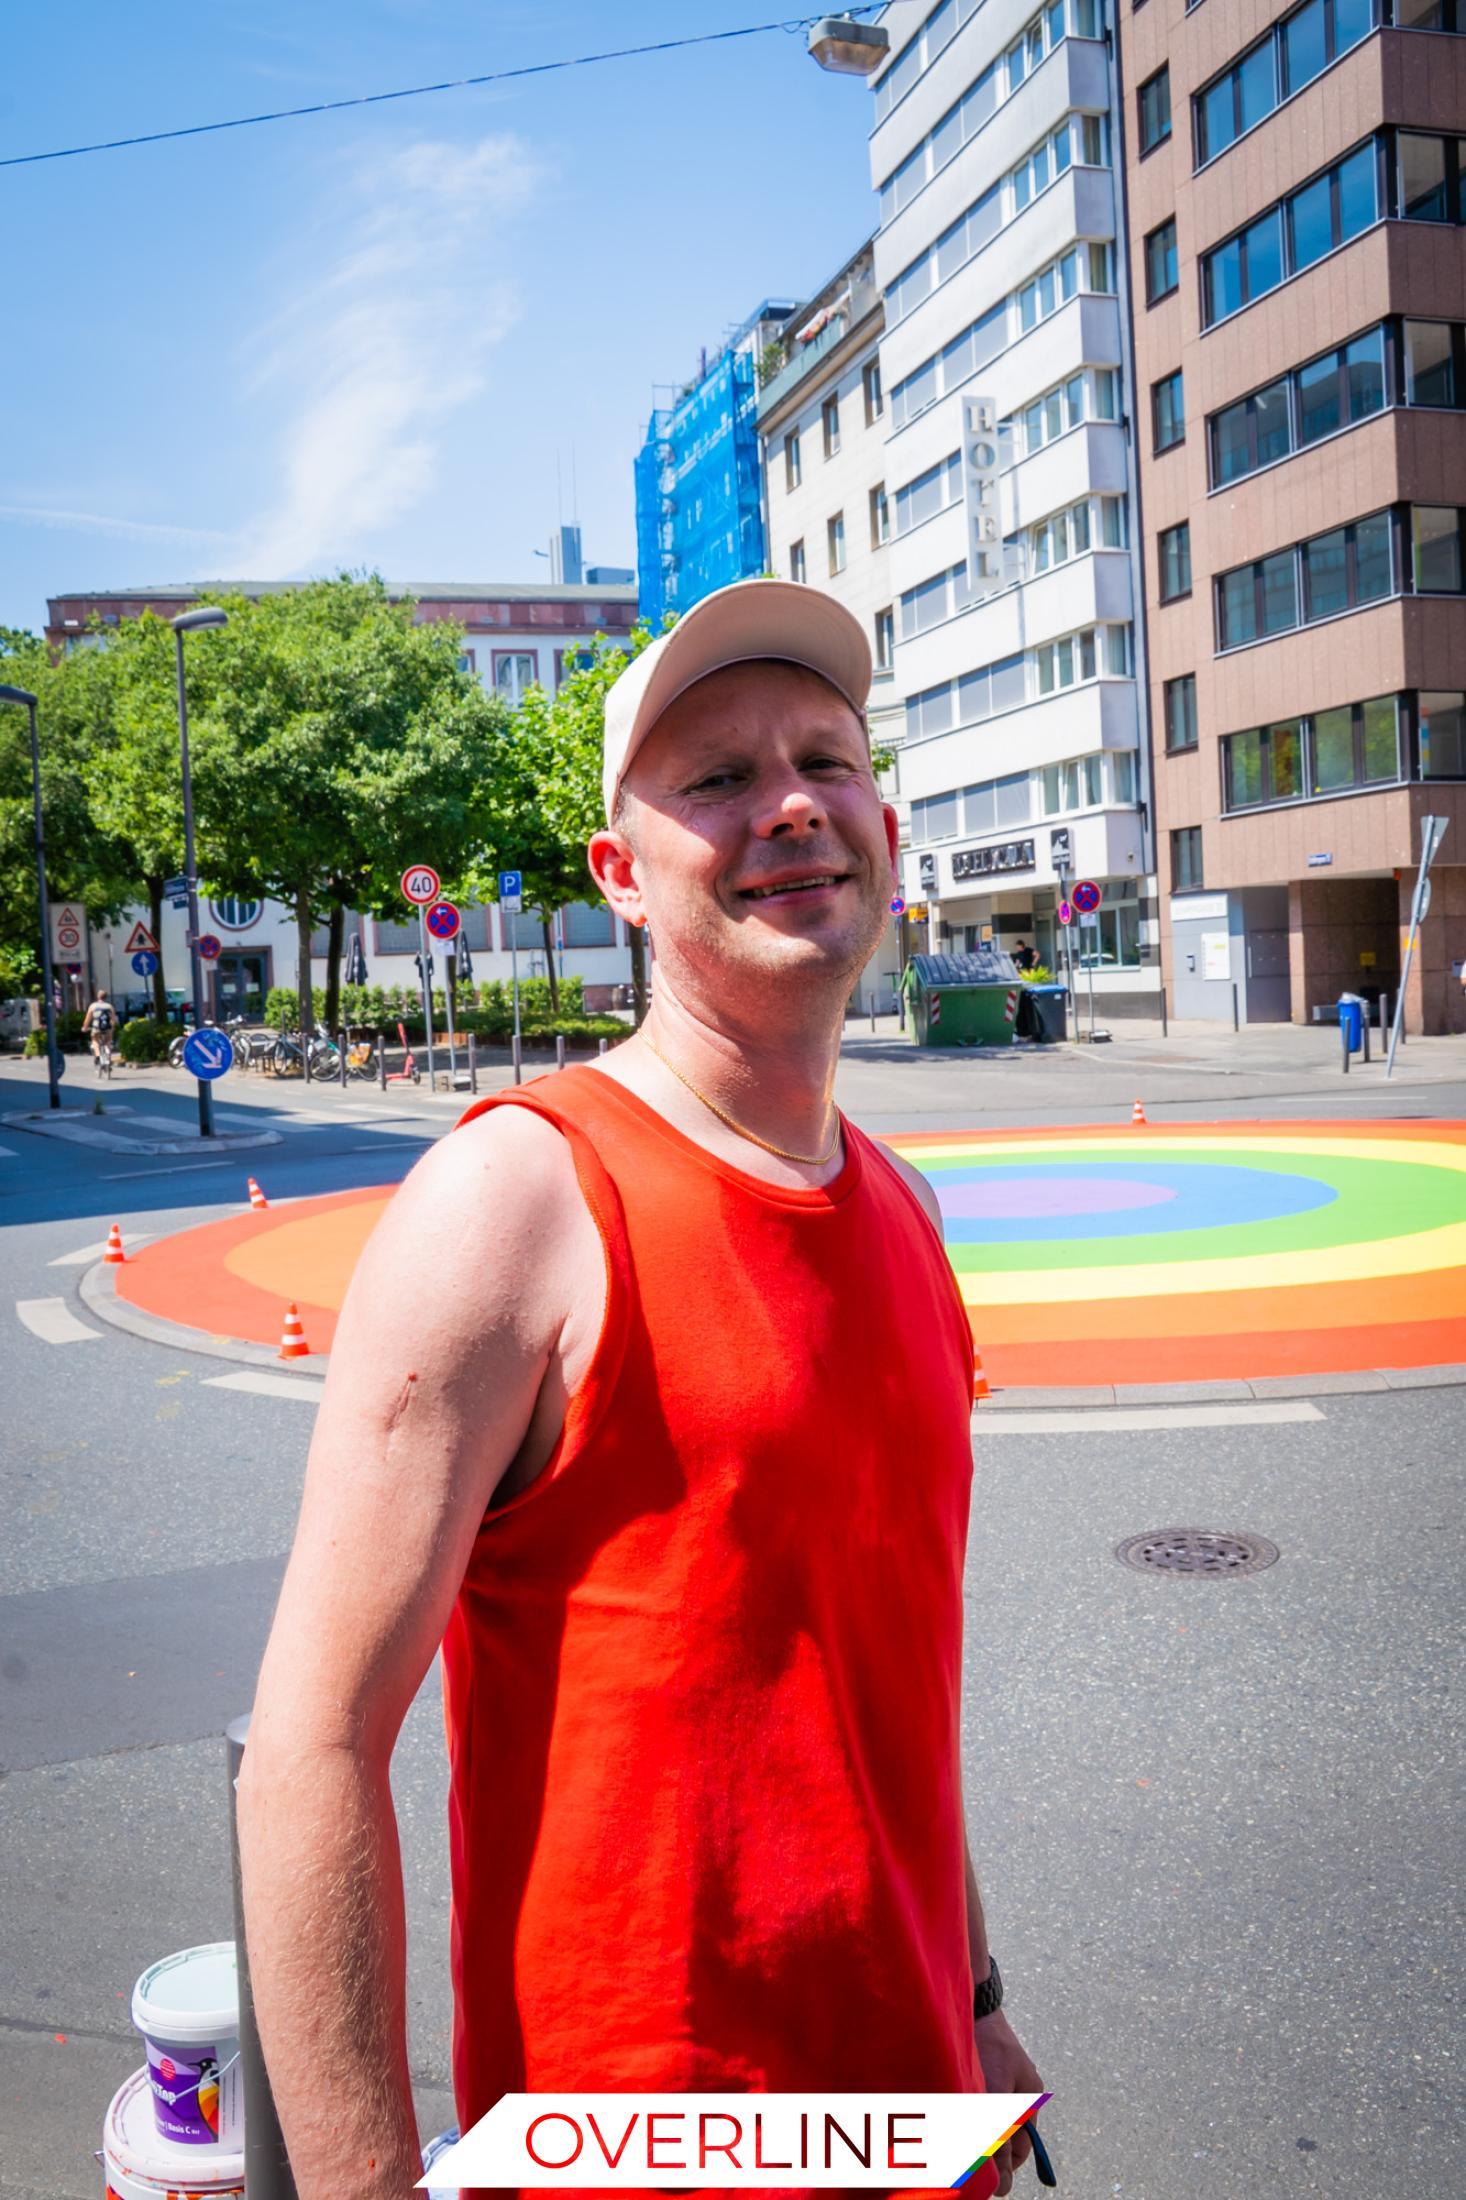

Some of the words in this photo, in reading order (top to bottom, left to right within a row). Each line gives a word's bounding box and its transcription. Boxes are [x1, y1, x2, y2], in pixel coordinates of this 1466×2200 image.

[968, 405, 1000, 578] HOTEL
[410, 876, 432, 893] 40
[504, 875, 516, 894] P
